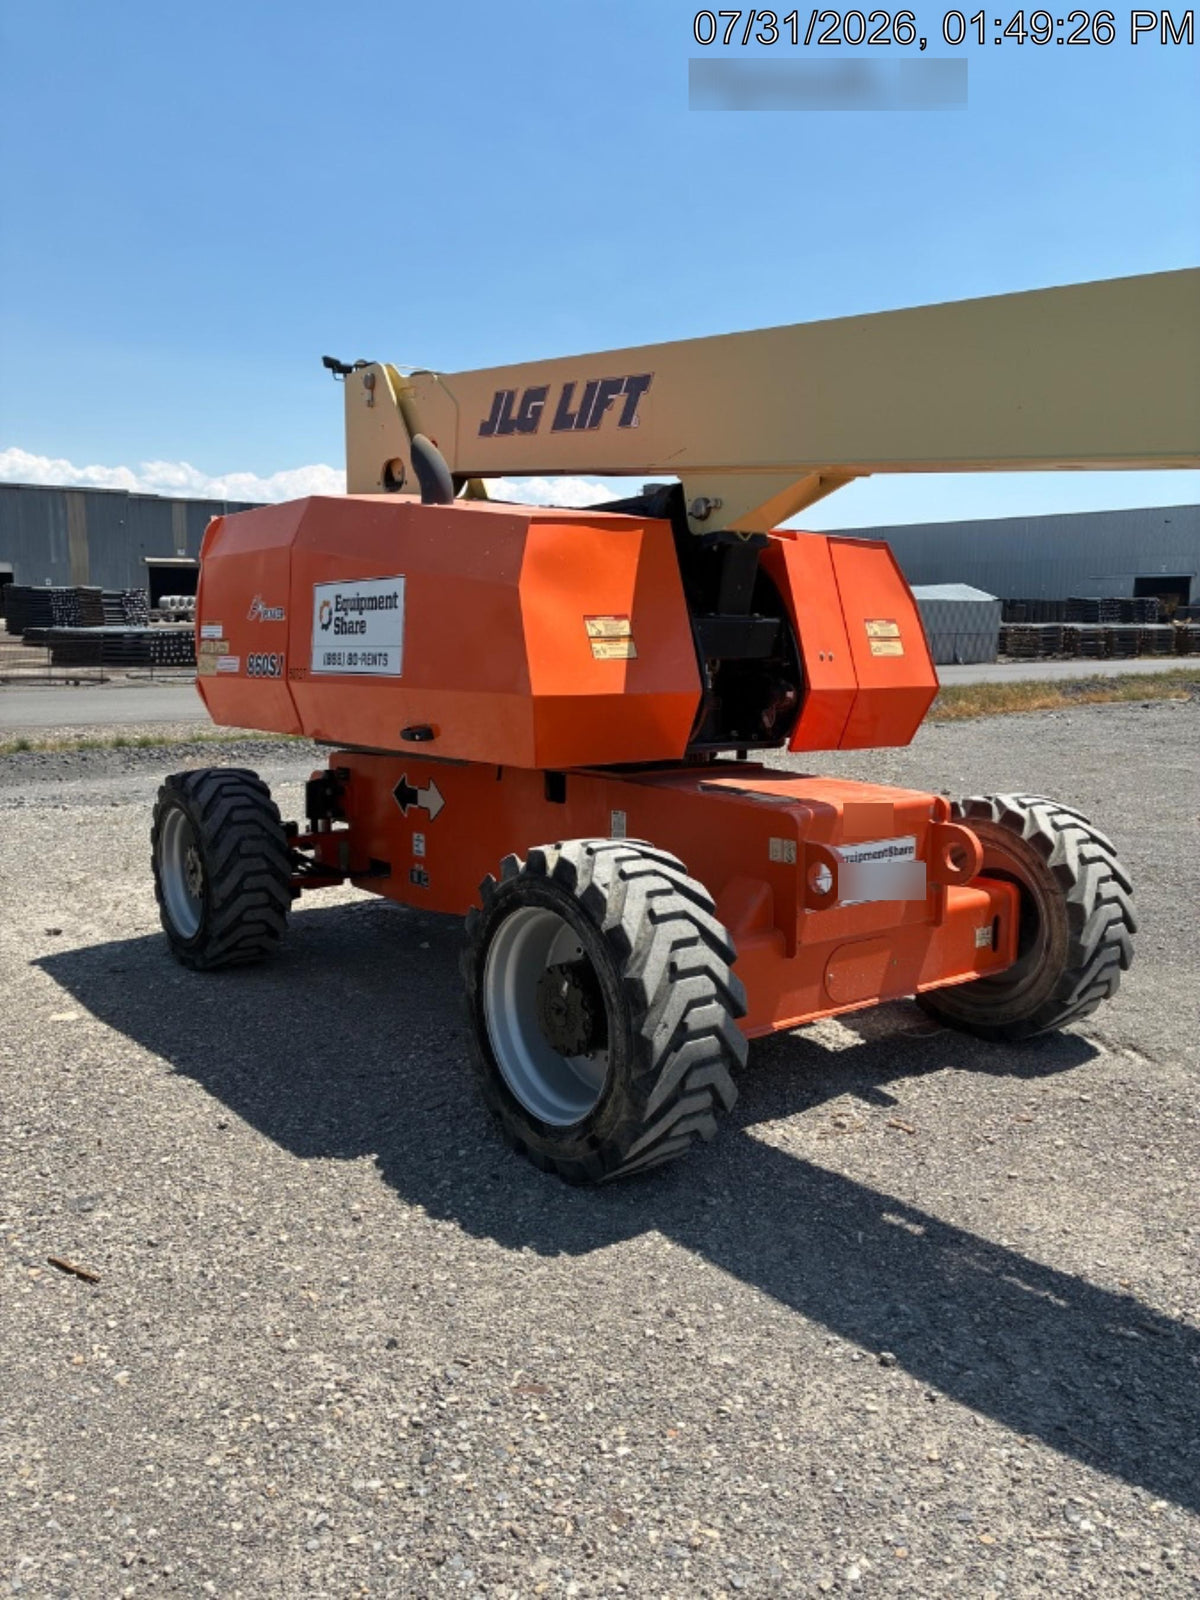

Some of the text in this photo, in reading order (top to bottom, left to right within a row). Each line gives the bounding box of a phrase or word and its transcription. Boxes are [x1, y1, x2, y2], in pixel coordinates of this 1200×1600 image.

[478, 372, 655, 439] JLG LIFT
[334, 591, 399, 616] Equipment
[333, 616, 367, 635] Share
